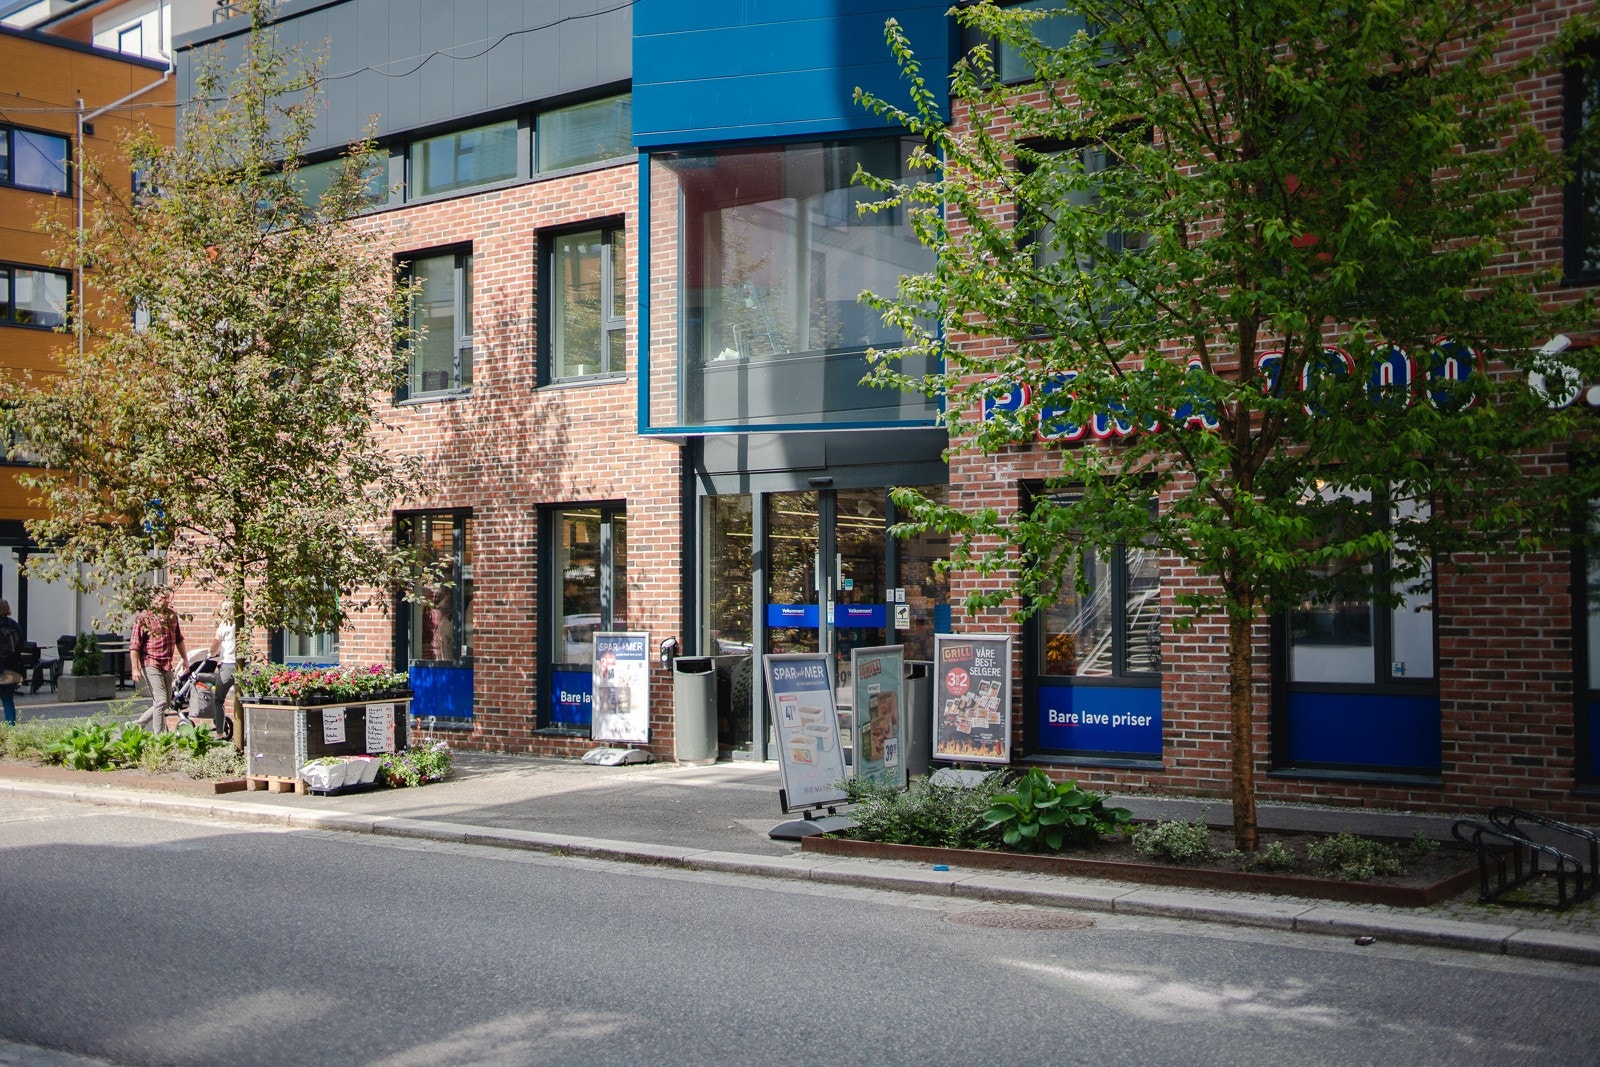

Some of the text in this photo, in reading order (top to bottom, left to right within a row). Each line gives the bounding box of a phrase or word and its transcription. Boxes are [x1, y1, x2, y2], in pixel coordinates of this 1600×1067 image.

[944, 647, 971, 659] GRILL
[975, 646, 996, 658] VÅRE
[974, 657, 997, 667] BEST-
[773, 667, 797, 681] SPAR
[804, 665, 825, 679] MER
[969, 667, 1002, 677] SELGERE
[947, 672, 956, 687] 3
[959, 672, 968, 687] 2
[560, 691, 581, 702] Bare
[1048, 709, 1152, 727] Bare lave priser
